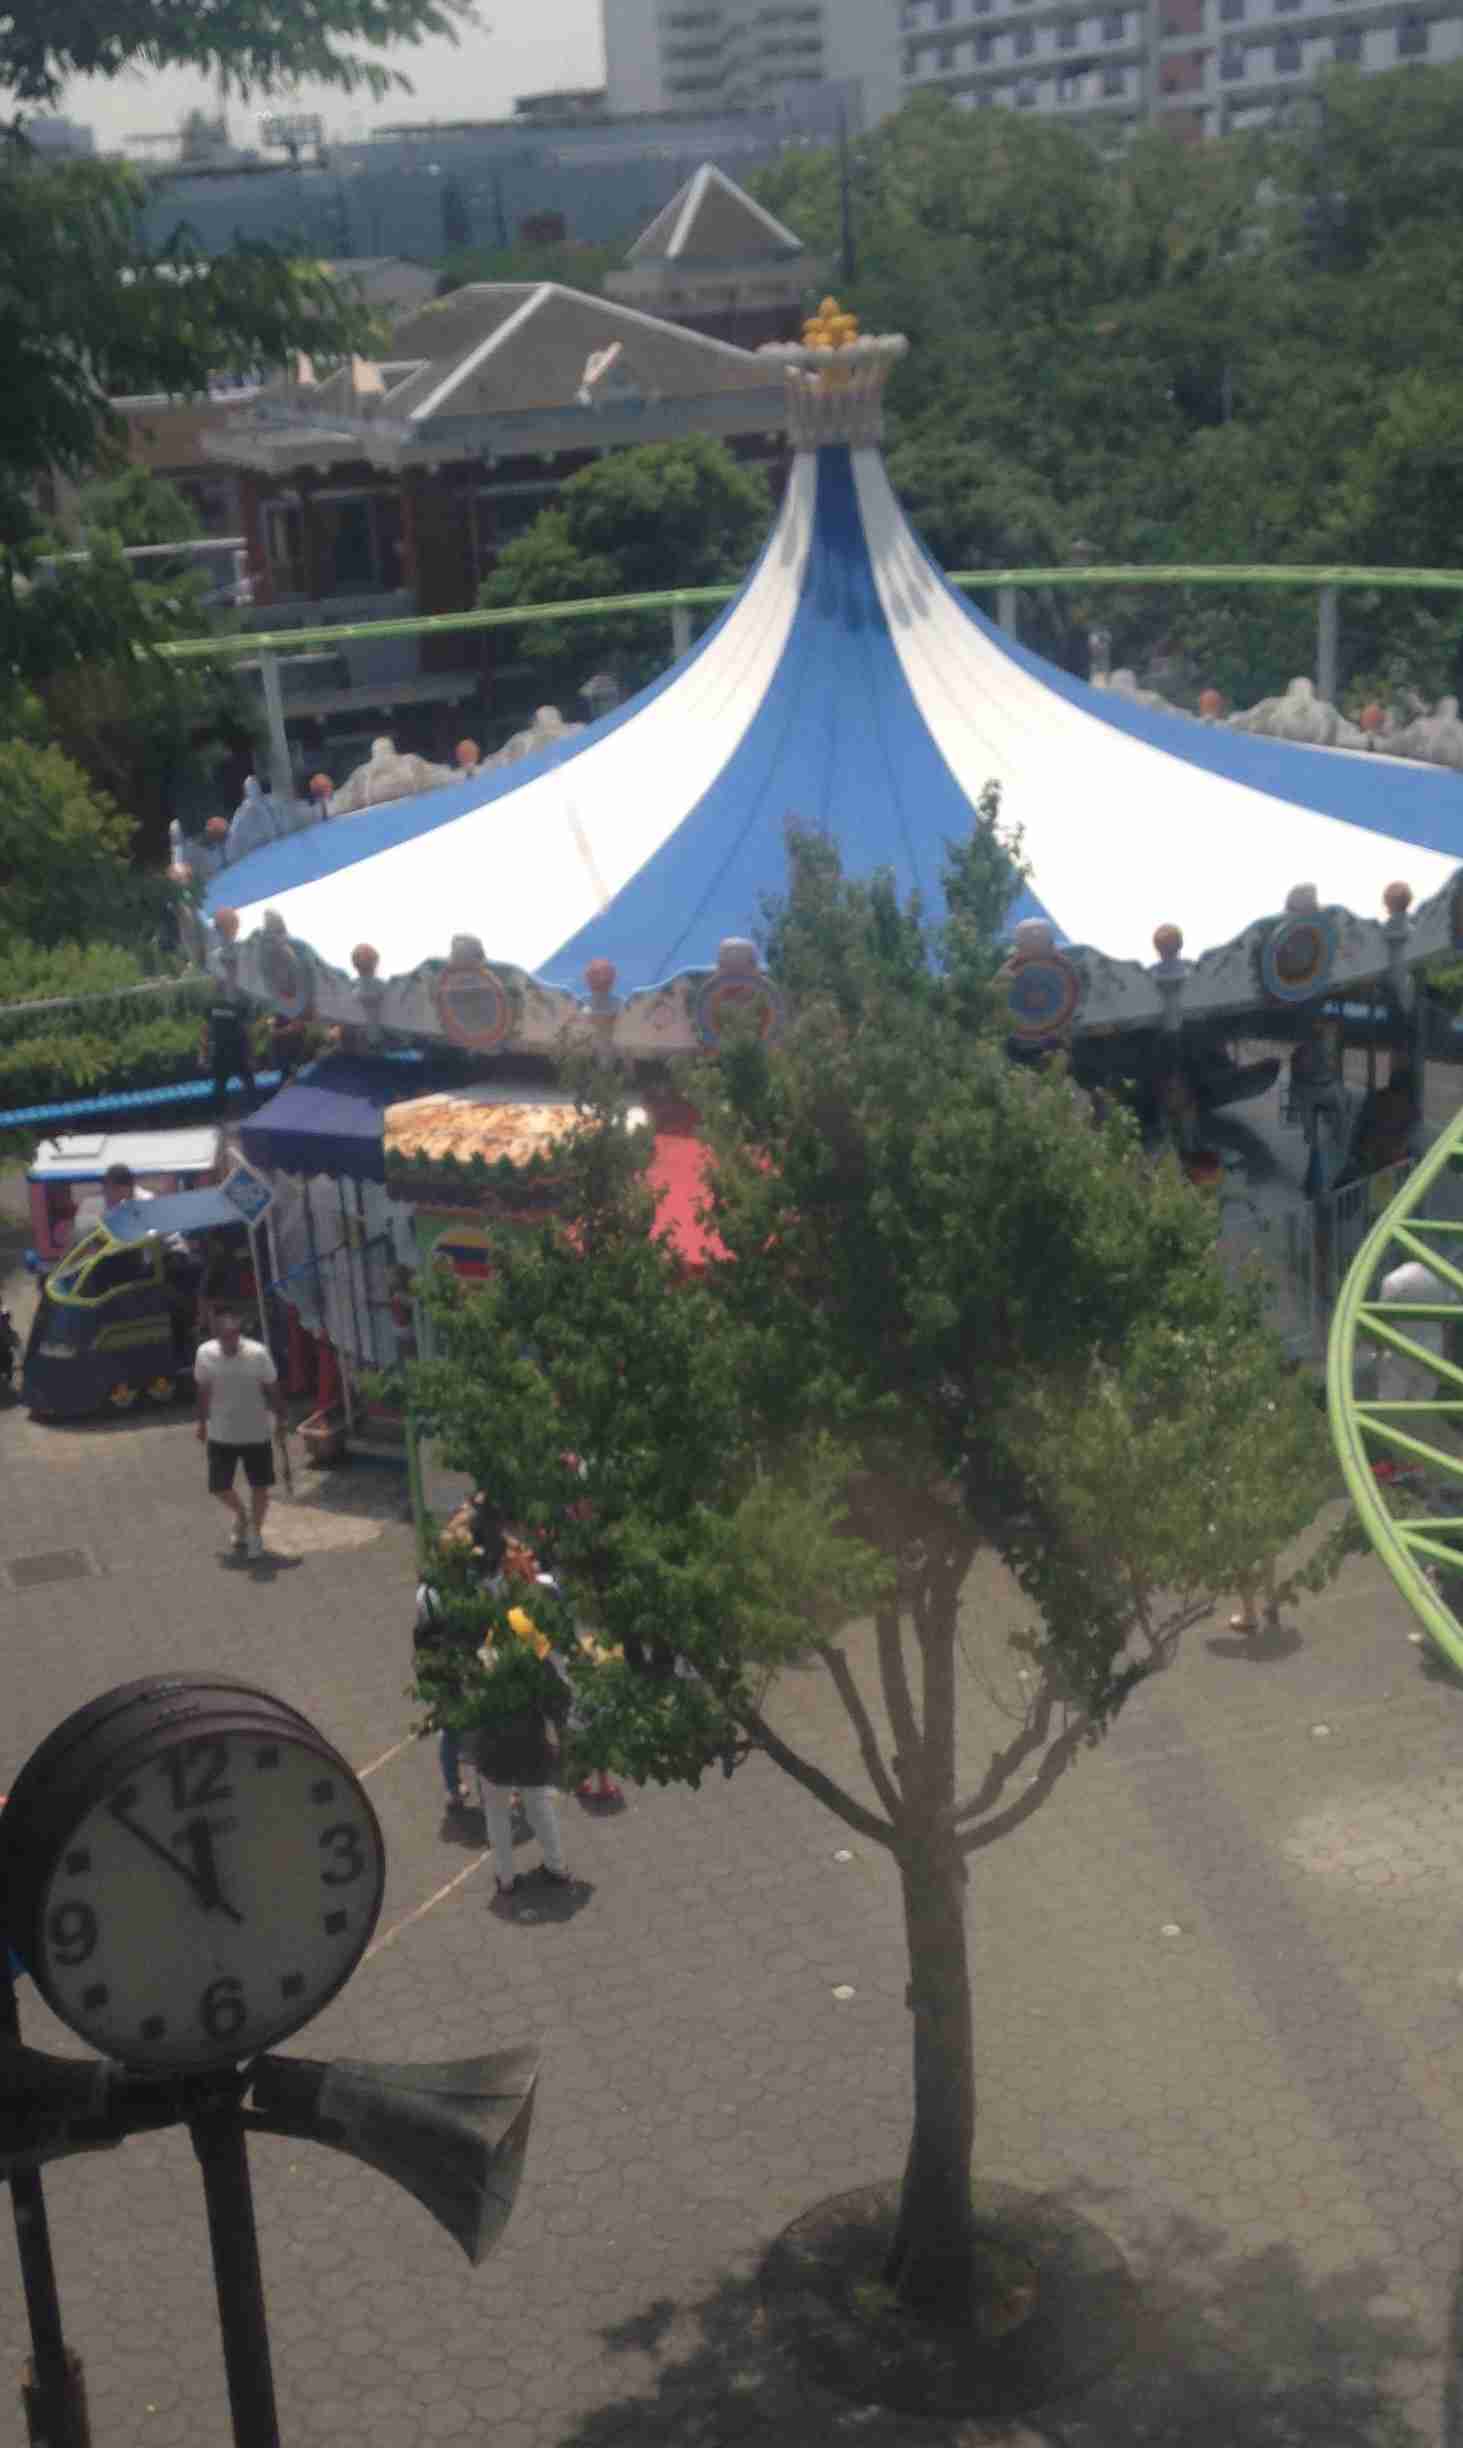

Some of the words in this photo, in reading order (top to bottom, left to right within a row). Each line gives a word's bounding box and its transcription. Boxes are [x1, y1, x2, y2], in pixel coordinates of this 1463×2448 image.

[158, 1740, 233, 1809] 12
[319, 1822, 364, 1885] 3
[48, 1900, 98, 1966] 9
[201, 1976, 246, 2040] 6
